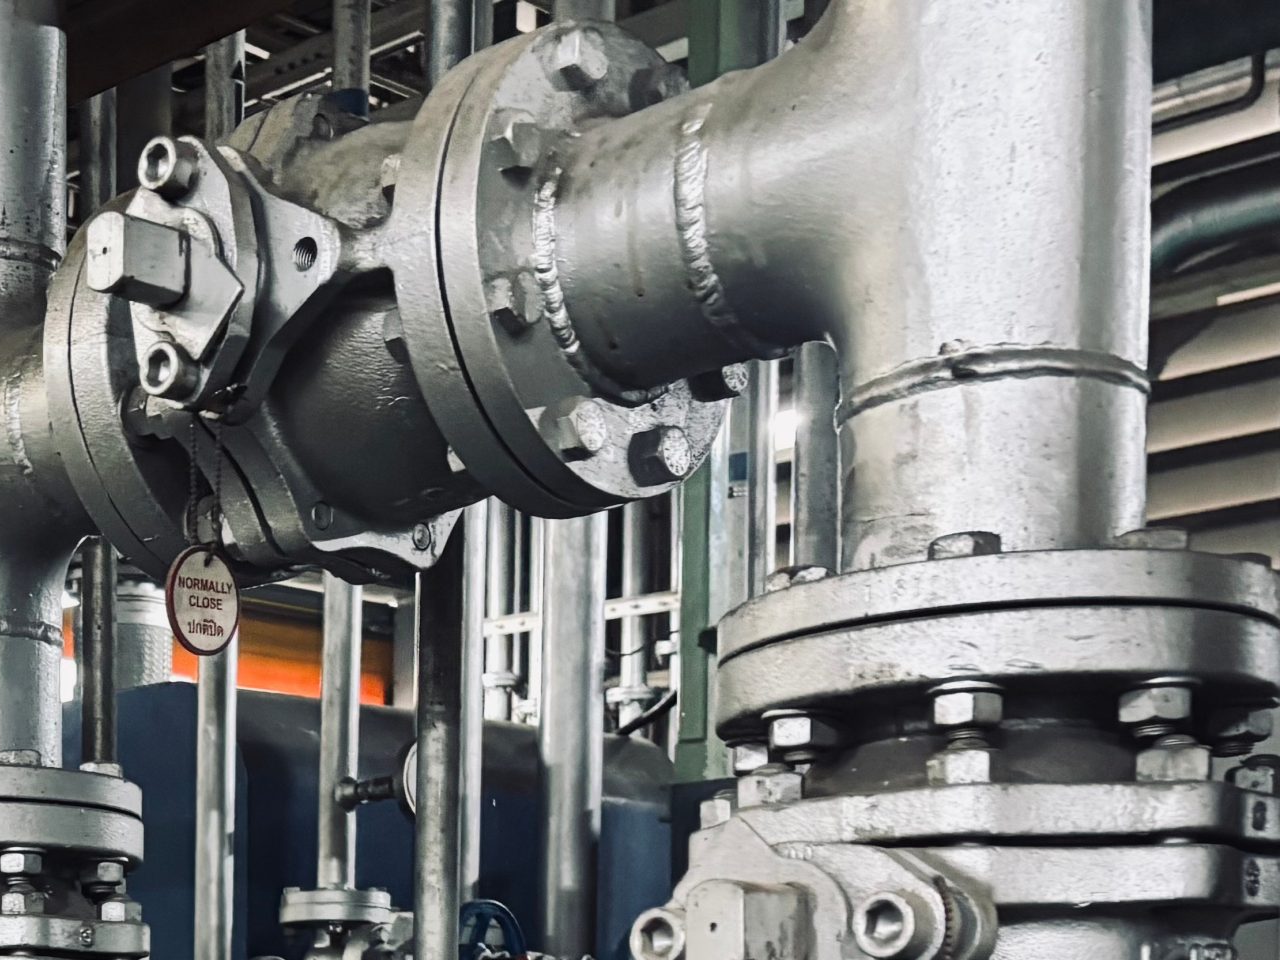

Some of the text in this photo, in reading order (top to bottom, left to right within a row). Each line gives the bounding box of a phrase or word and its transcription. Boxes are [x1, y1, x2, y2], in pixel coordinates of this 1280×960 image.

[178, 576, 233, 595] NORMALLY
[189, 595, 223, 611] CLOSE
[187, 618, 224, 637] ปกติปิด
